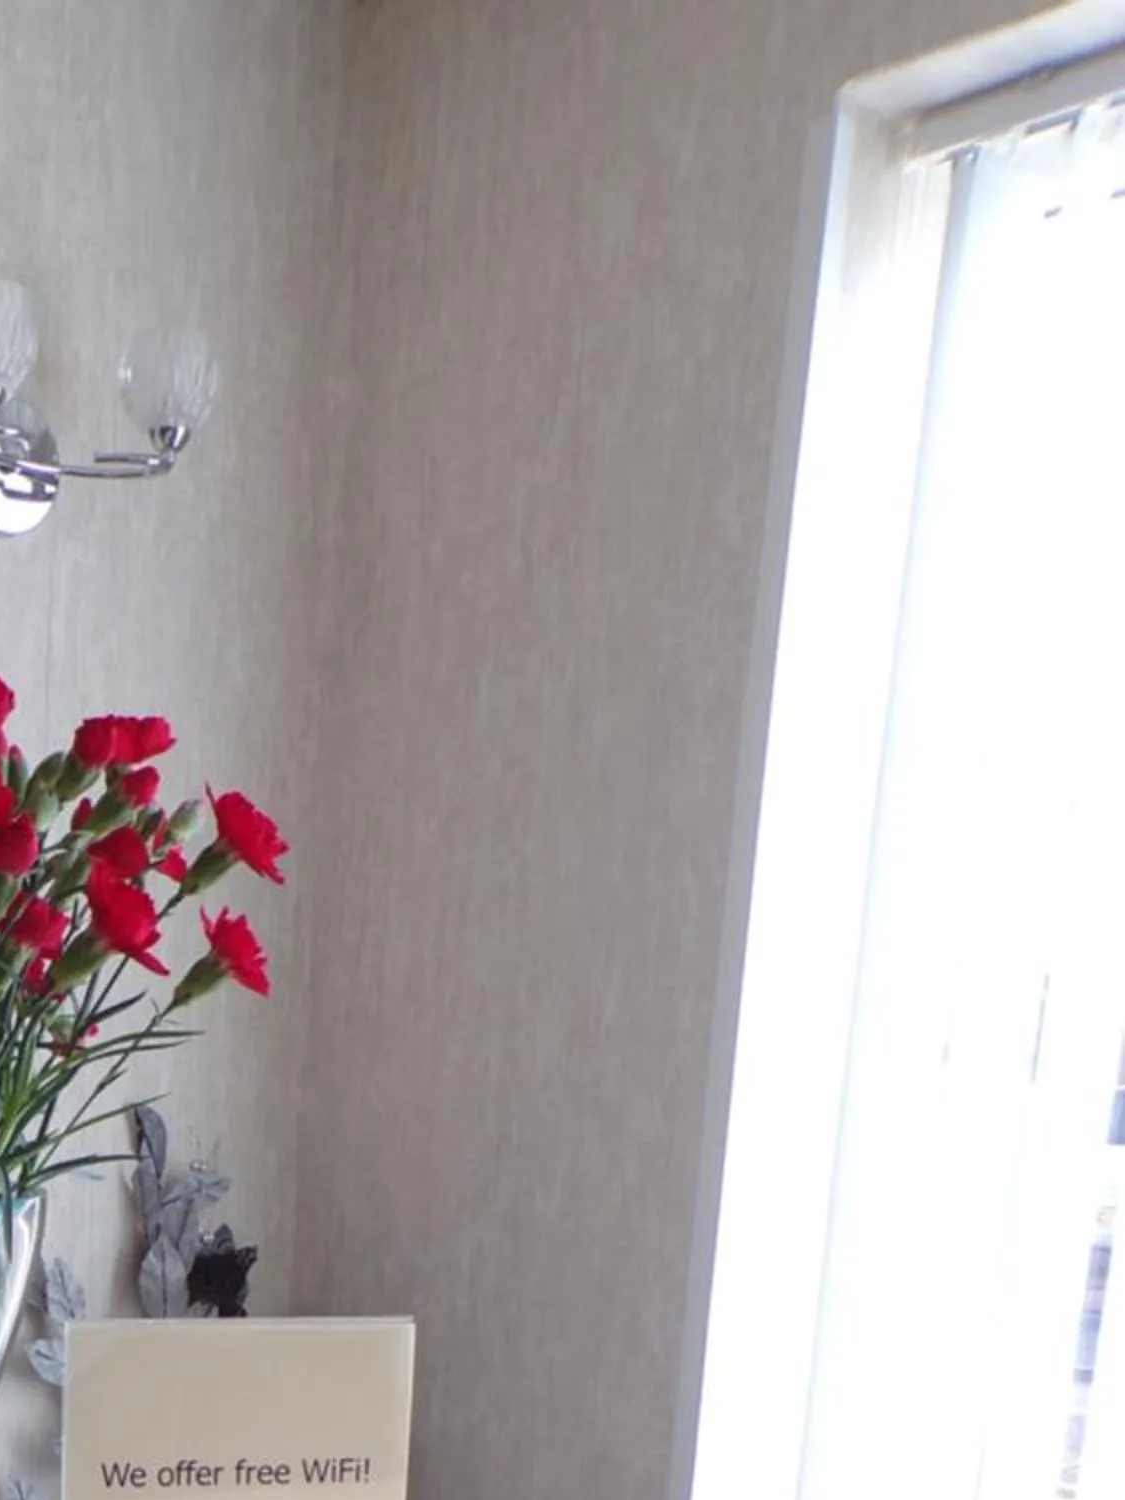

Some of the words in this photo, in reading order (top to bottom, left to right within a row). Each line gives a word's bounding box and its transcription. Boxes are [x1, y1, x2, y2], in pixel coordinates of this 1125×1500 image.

[101, 1462, 147, 1488] We
[157, 1460, 224, 1487] offer
[235, 1458, 291, 1485] free
[302, 1458, 371, 1484] WiFi!
